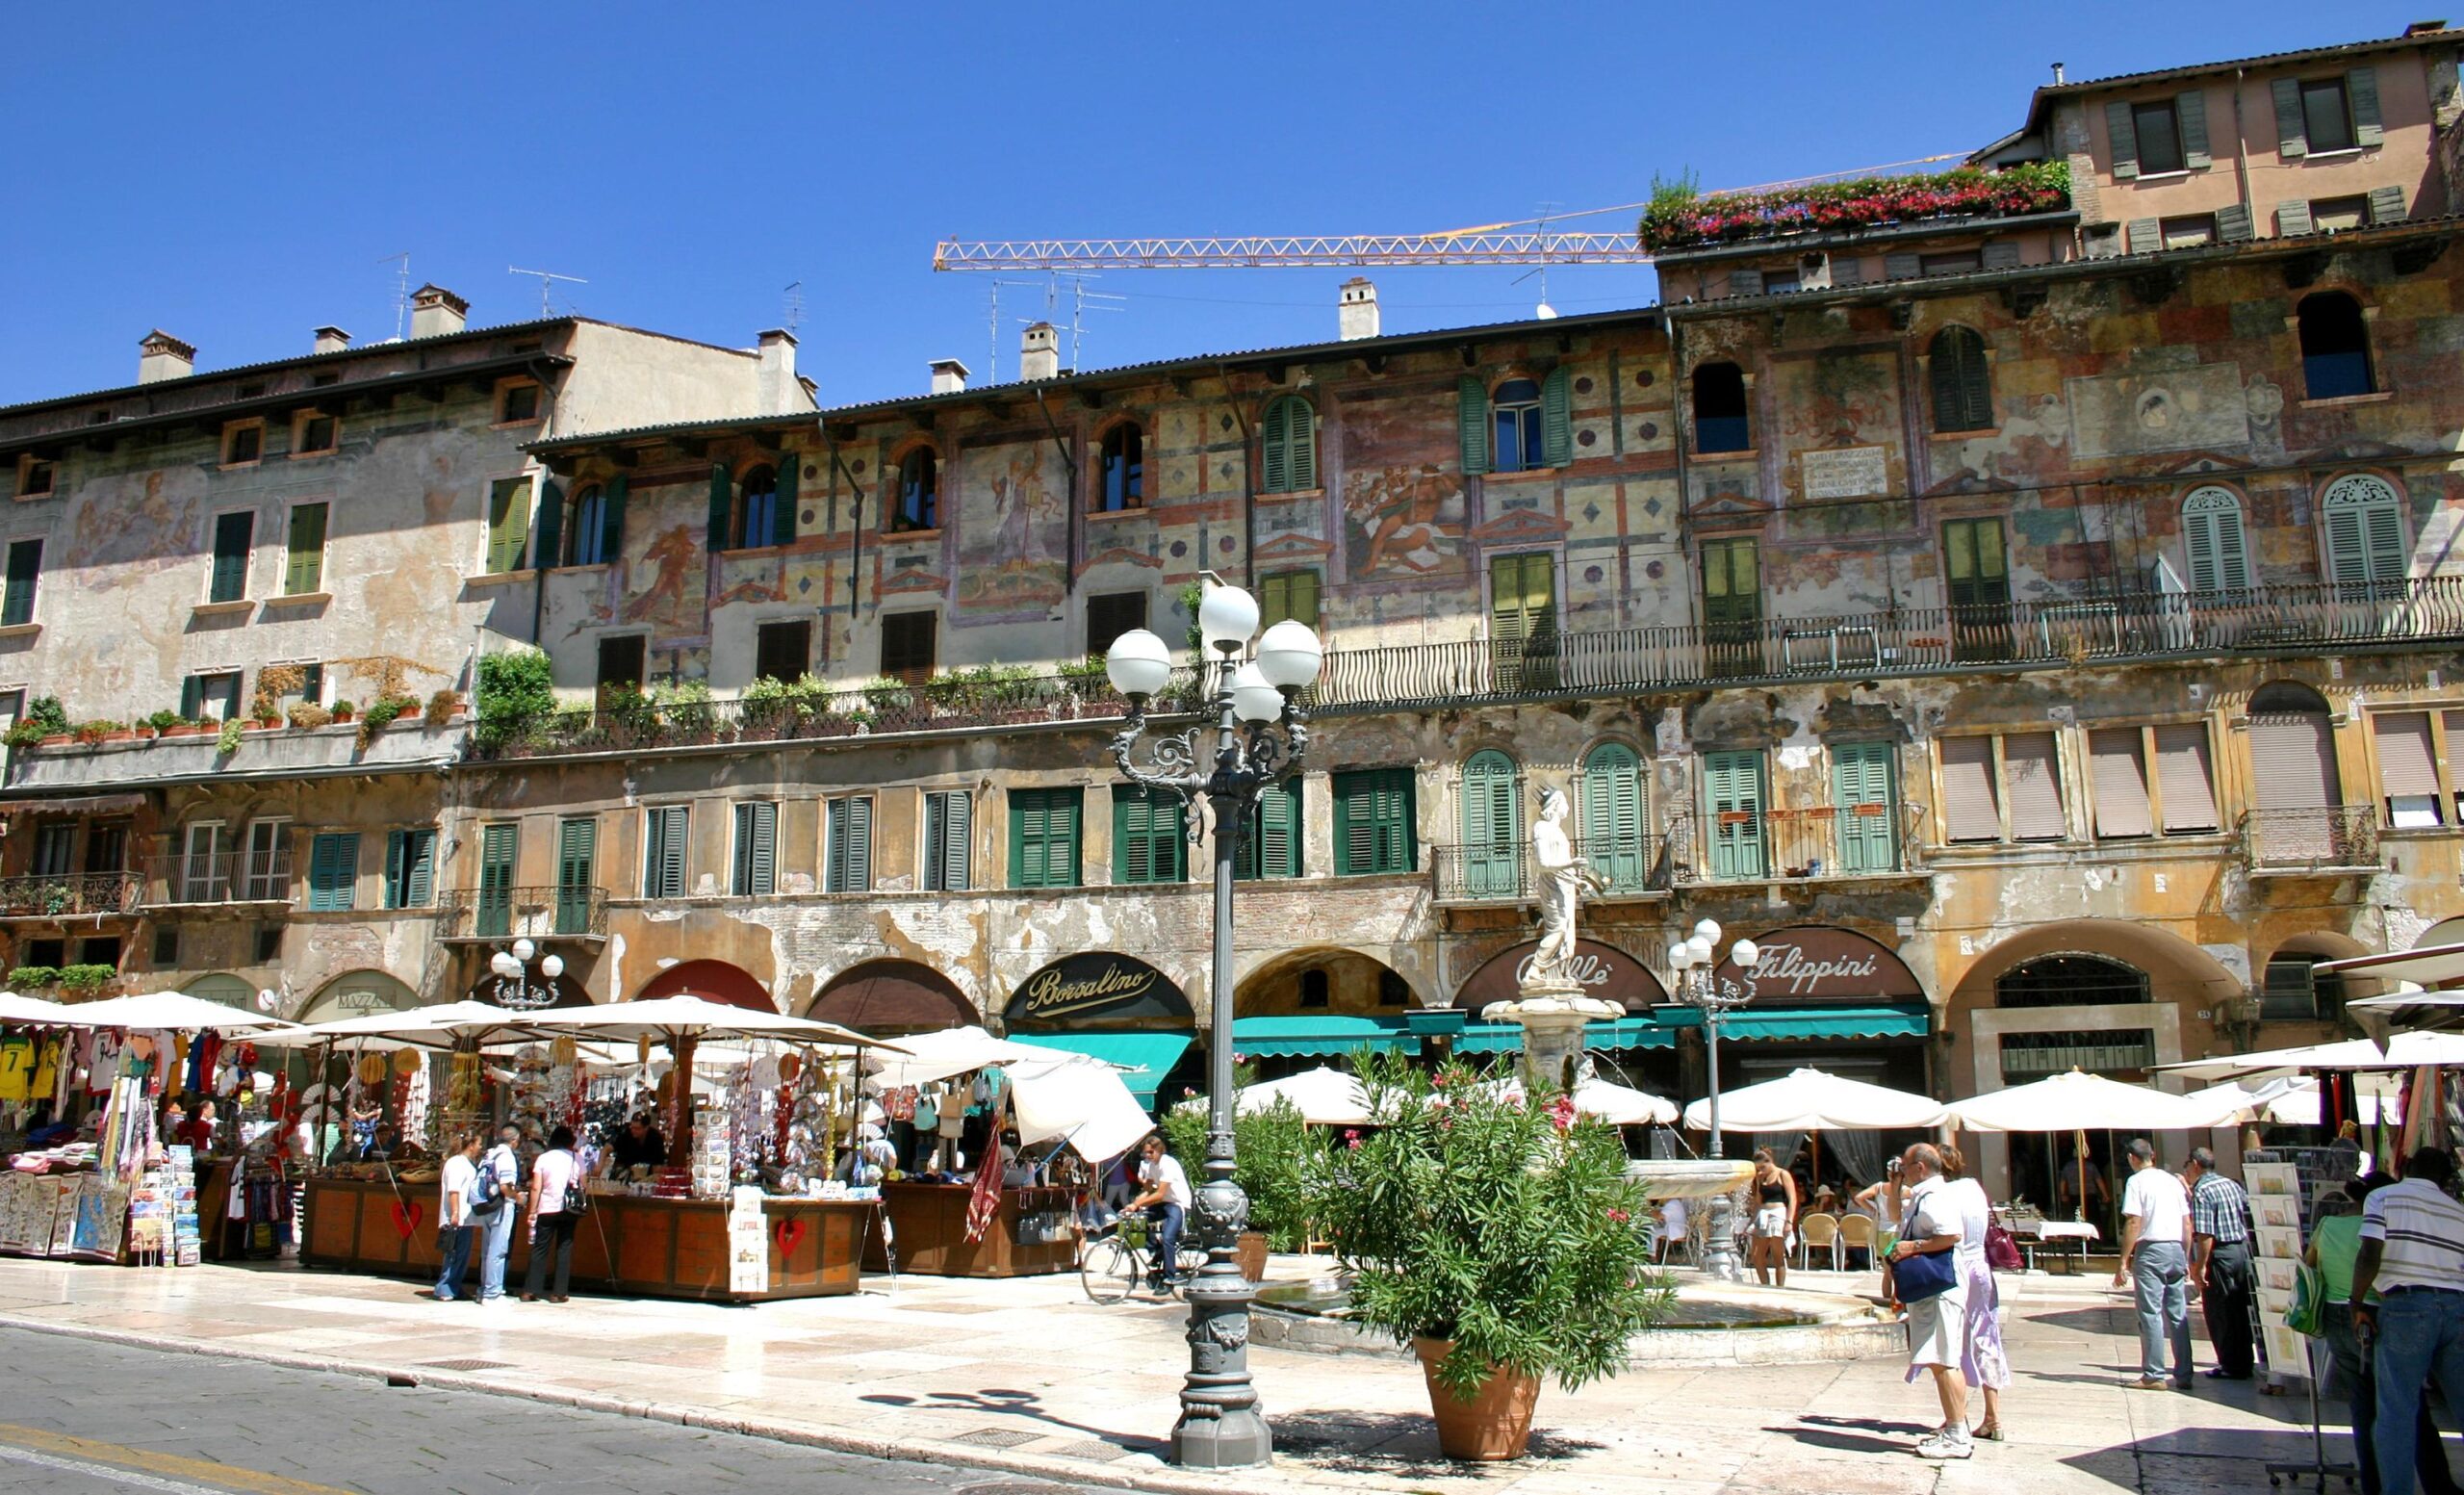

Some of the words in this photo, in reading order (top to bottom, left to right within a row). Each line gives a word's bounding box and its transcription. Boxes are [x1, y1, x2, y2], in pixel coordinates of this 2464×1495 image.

[1026, 962, 1157, 1017] Borsalino
[1752, 943, 1877, 993] Filippini
[8, 1052, 18, 1072] 7
